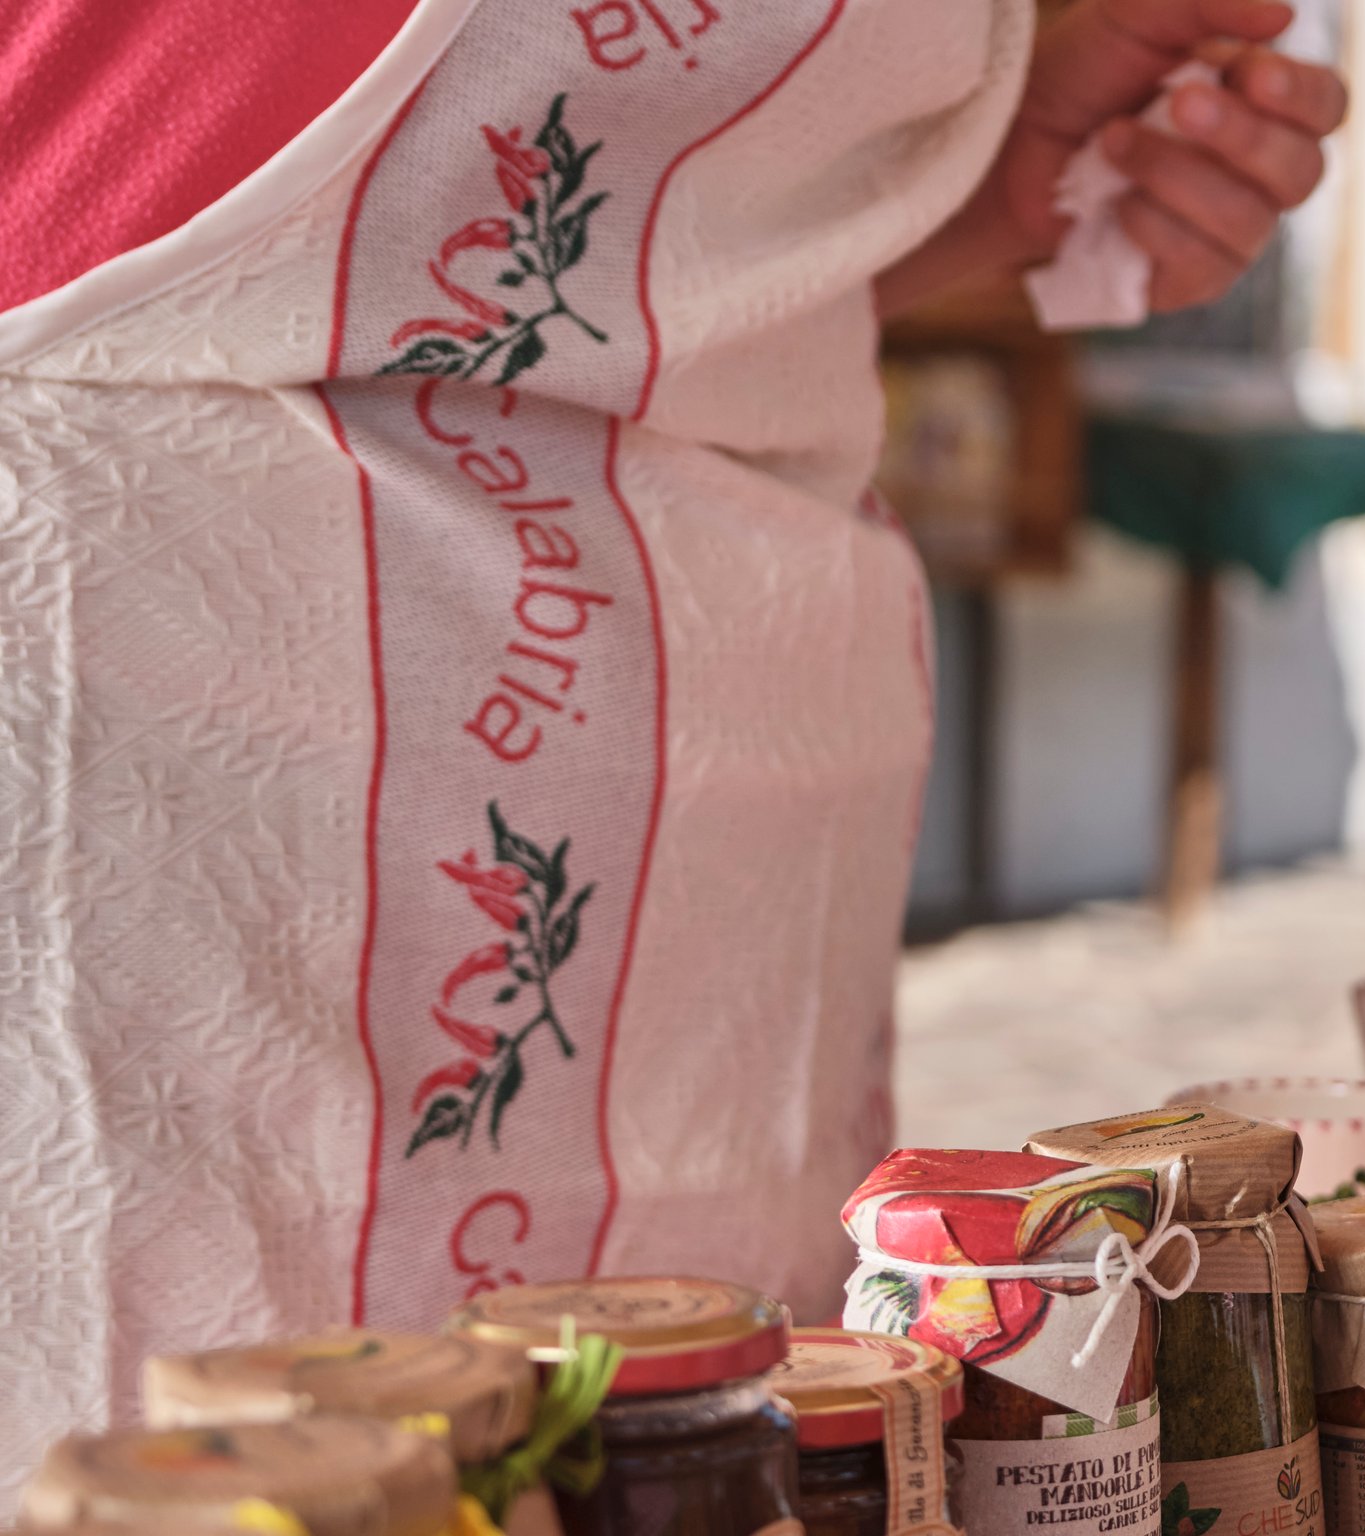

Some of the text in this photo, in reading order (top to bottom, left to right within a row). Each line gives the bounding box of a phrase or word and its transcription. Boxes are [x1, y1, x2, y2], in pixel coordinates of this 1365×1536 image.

[448, 1188, 532, 1302] C
[996, 1458, 1104, 1486] PESTATO
[1112, 1451, 1131, 1474] DI
[1039, 1469, 1144, 1507] MANDORLE
[1026, 1504, 1111, 1525] DELIZIOSO
[1115, 1490, 1149, 1513] SULLE
[1098, 1510, 1139, 1533] CARNE
[1141, 1508, 1147, 1521] E
